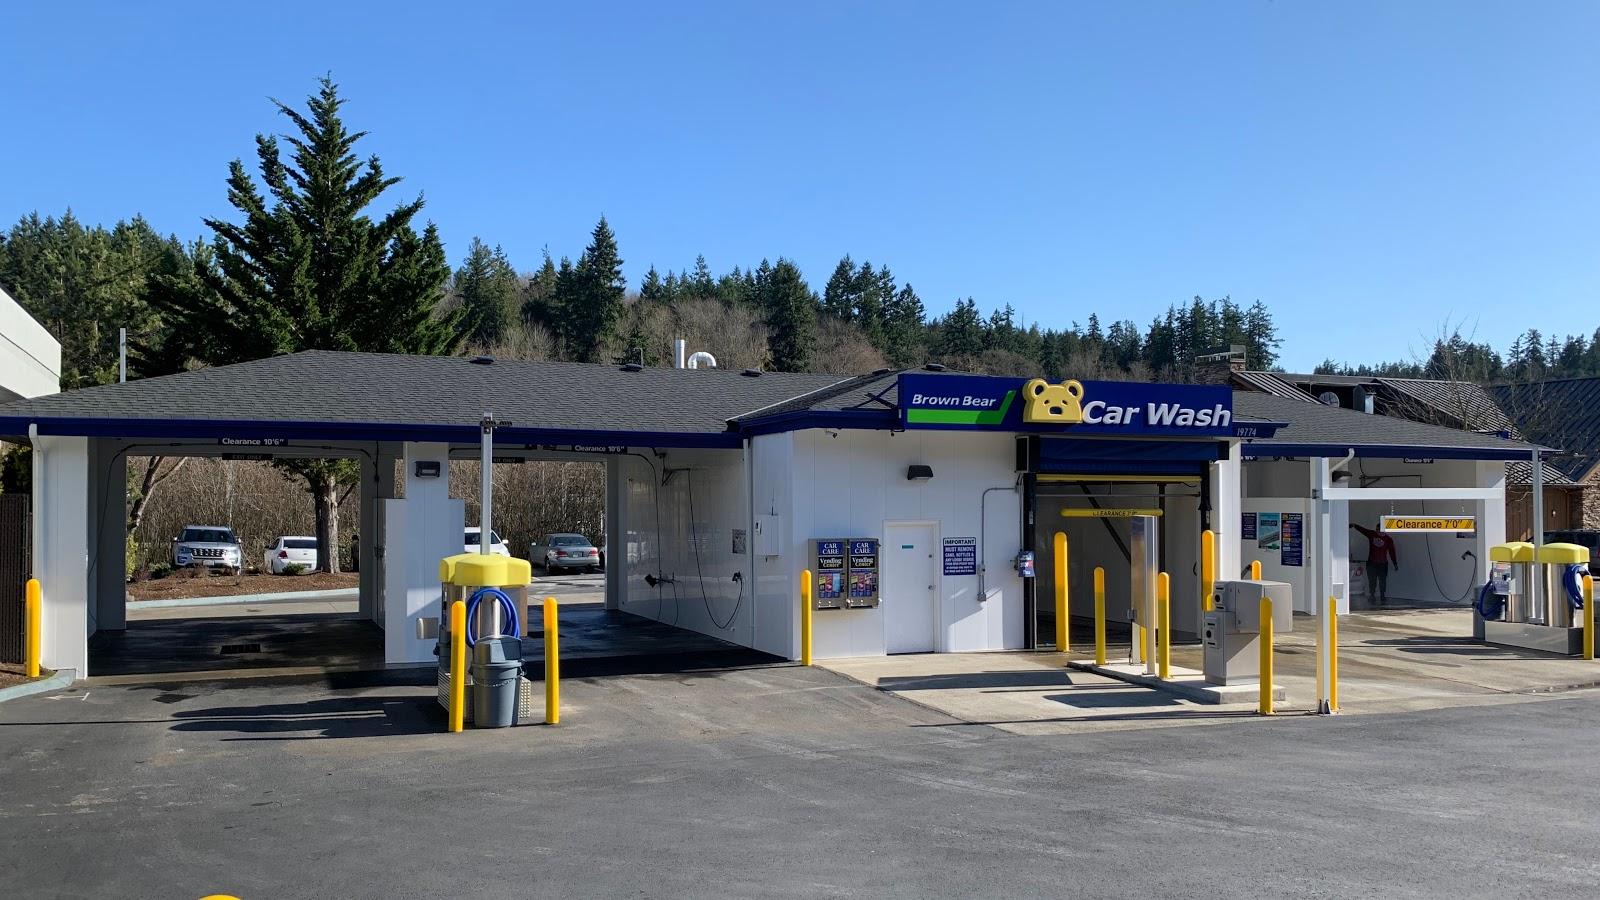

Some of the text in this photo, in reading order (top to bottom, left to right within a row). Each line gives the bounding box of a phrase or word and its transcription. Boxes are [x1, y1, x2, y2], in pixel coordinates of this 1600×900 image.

[912, 393, 996, 407] Brown Bear
[1083, 400, 1231, 427] Car Wash
[1236, 427, 1257, 437] 19774
[222, 437, 261, 445] Clearance
[574, 444, 606, 453] Clearance
[1396, 519, 1463, 529] Clearance 7'0"
